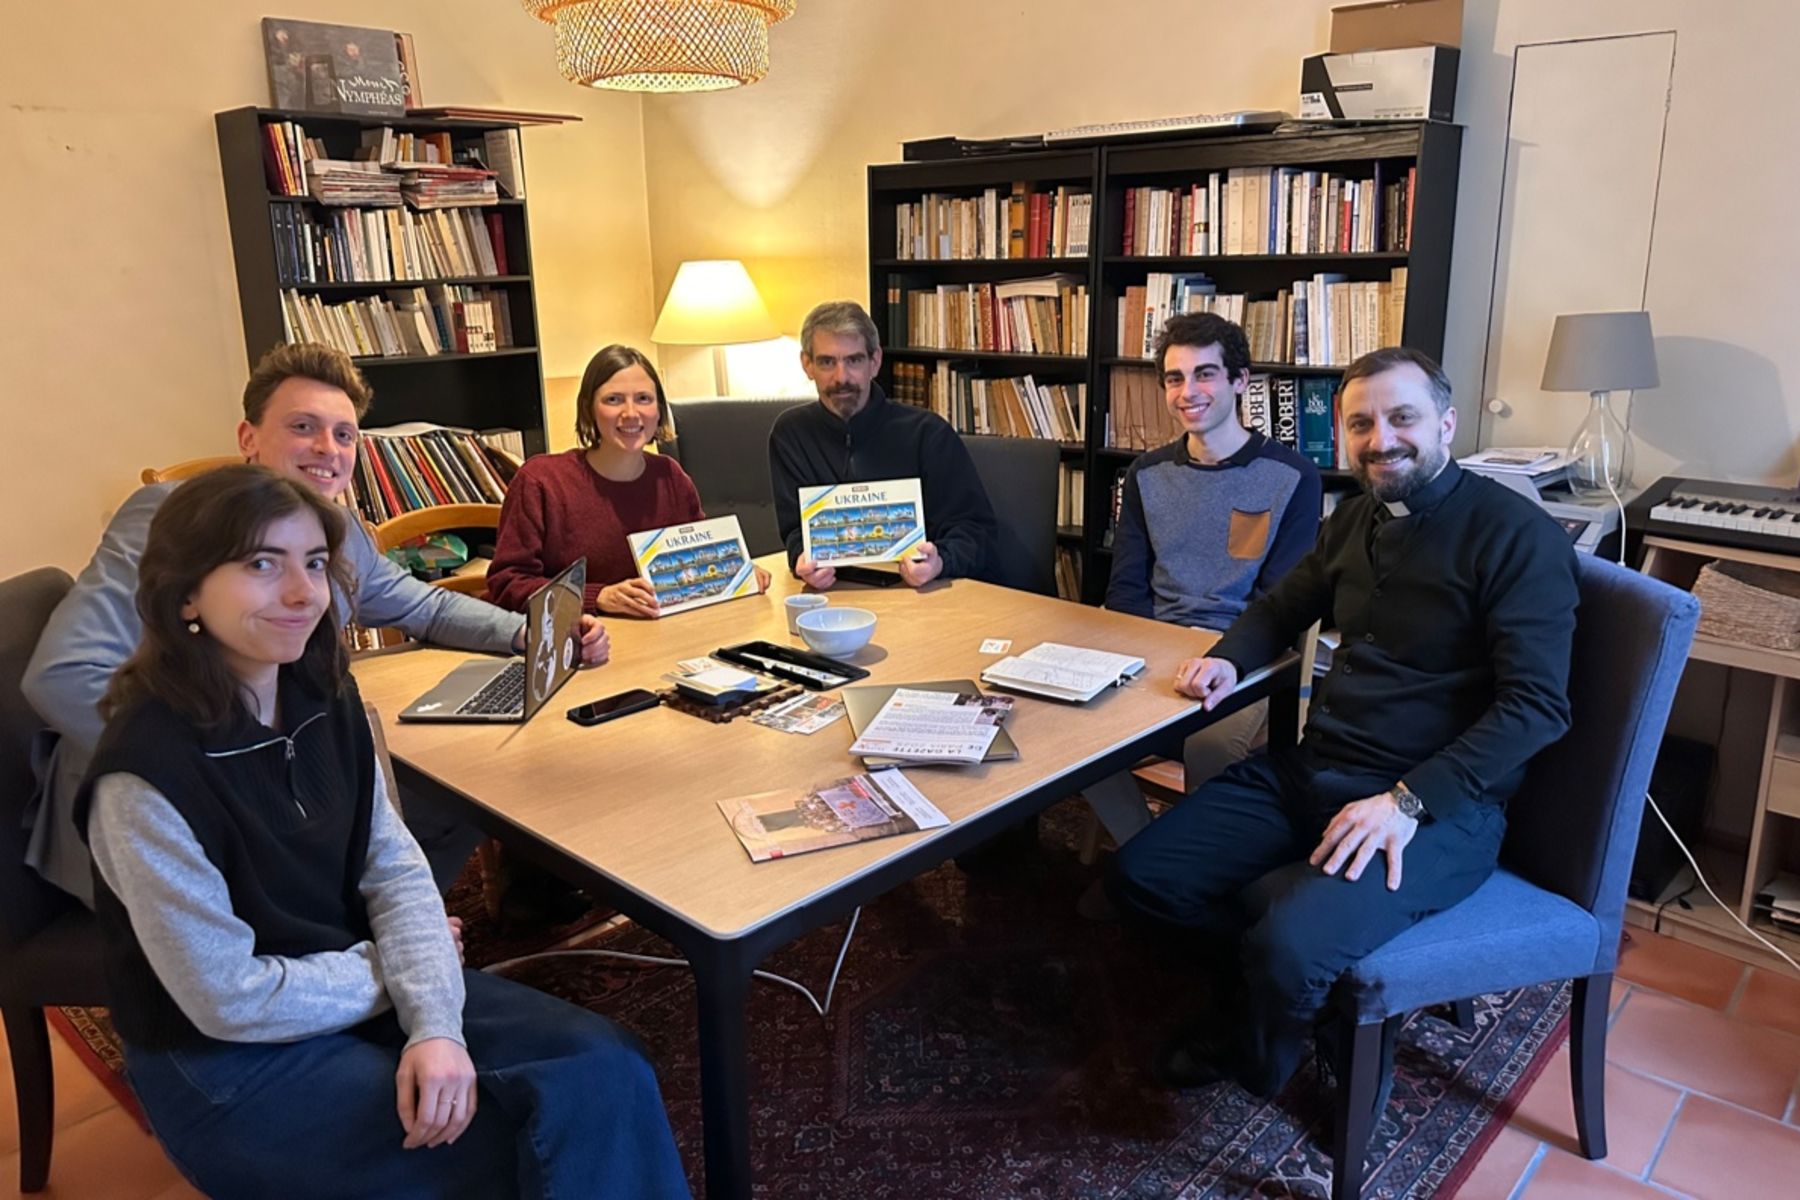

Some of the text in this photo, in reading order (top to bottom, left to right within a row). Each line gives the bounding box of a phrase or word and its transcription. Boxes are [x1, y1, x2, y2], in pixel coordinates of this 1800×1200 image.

[348, 75, 399, 93] Monet
[1279, 379, 1295, 441] ROBERT
[835, 491, 887, 505] UKRAINE
[666, 531, 713, 549] UKRAINE
